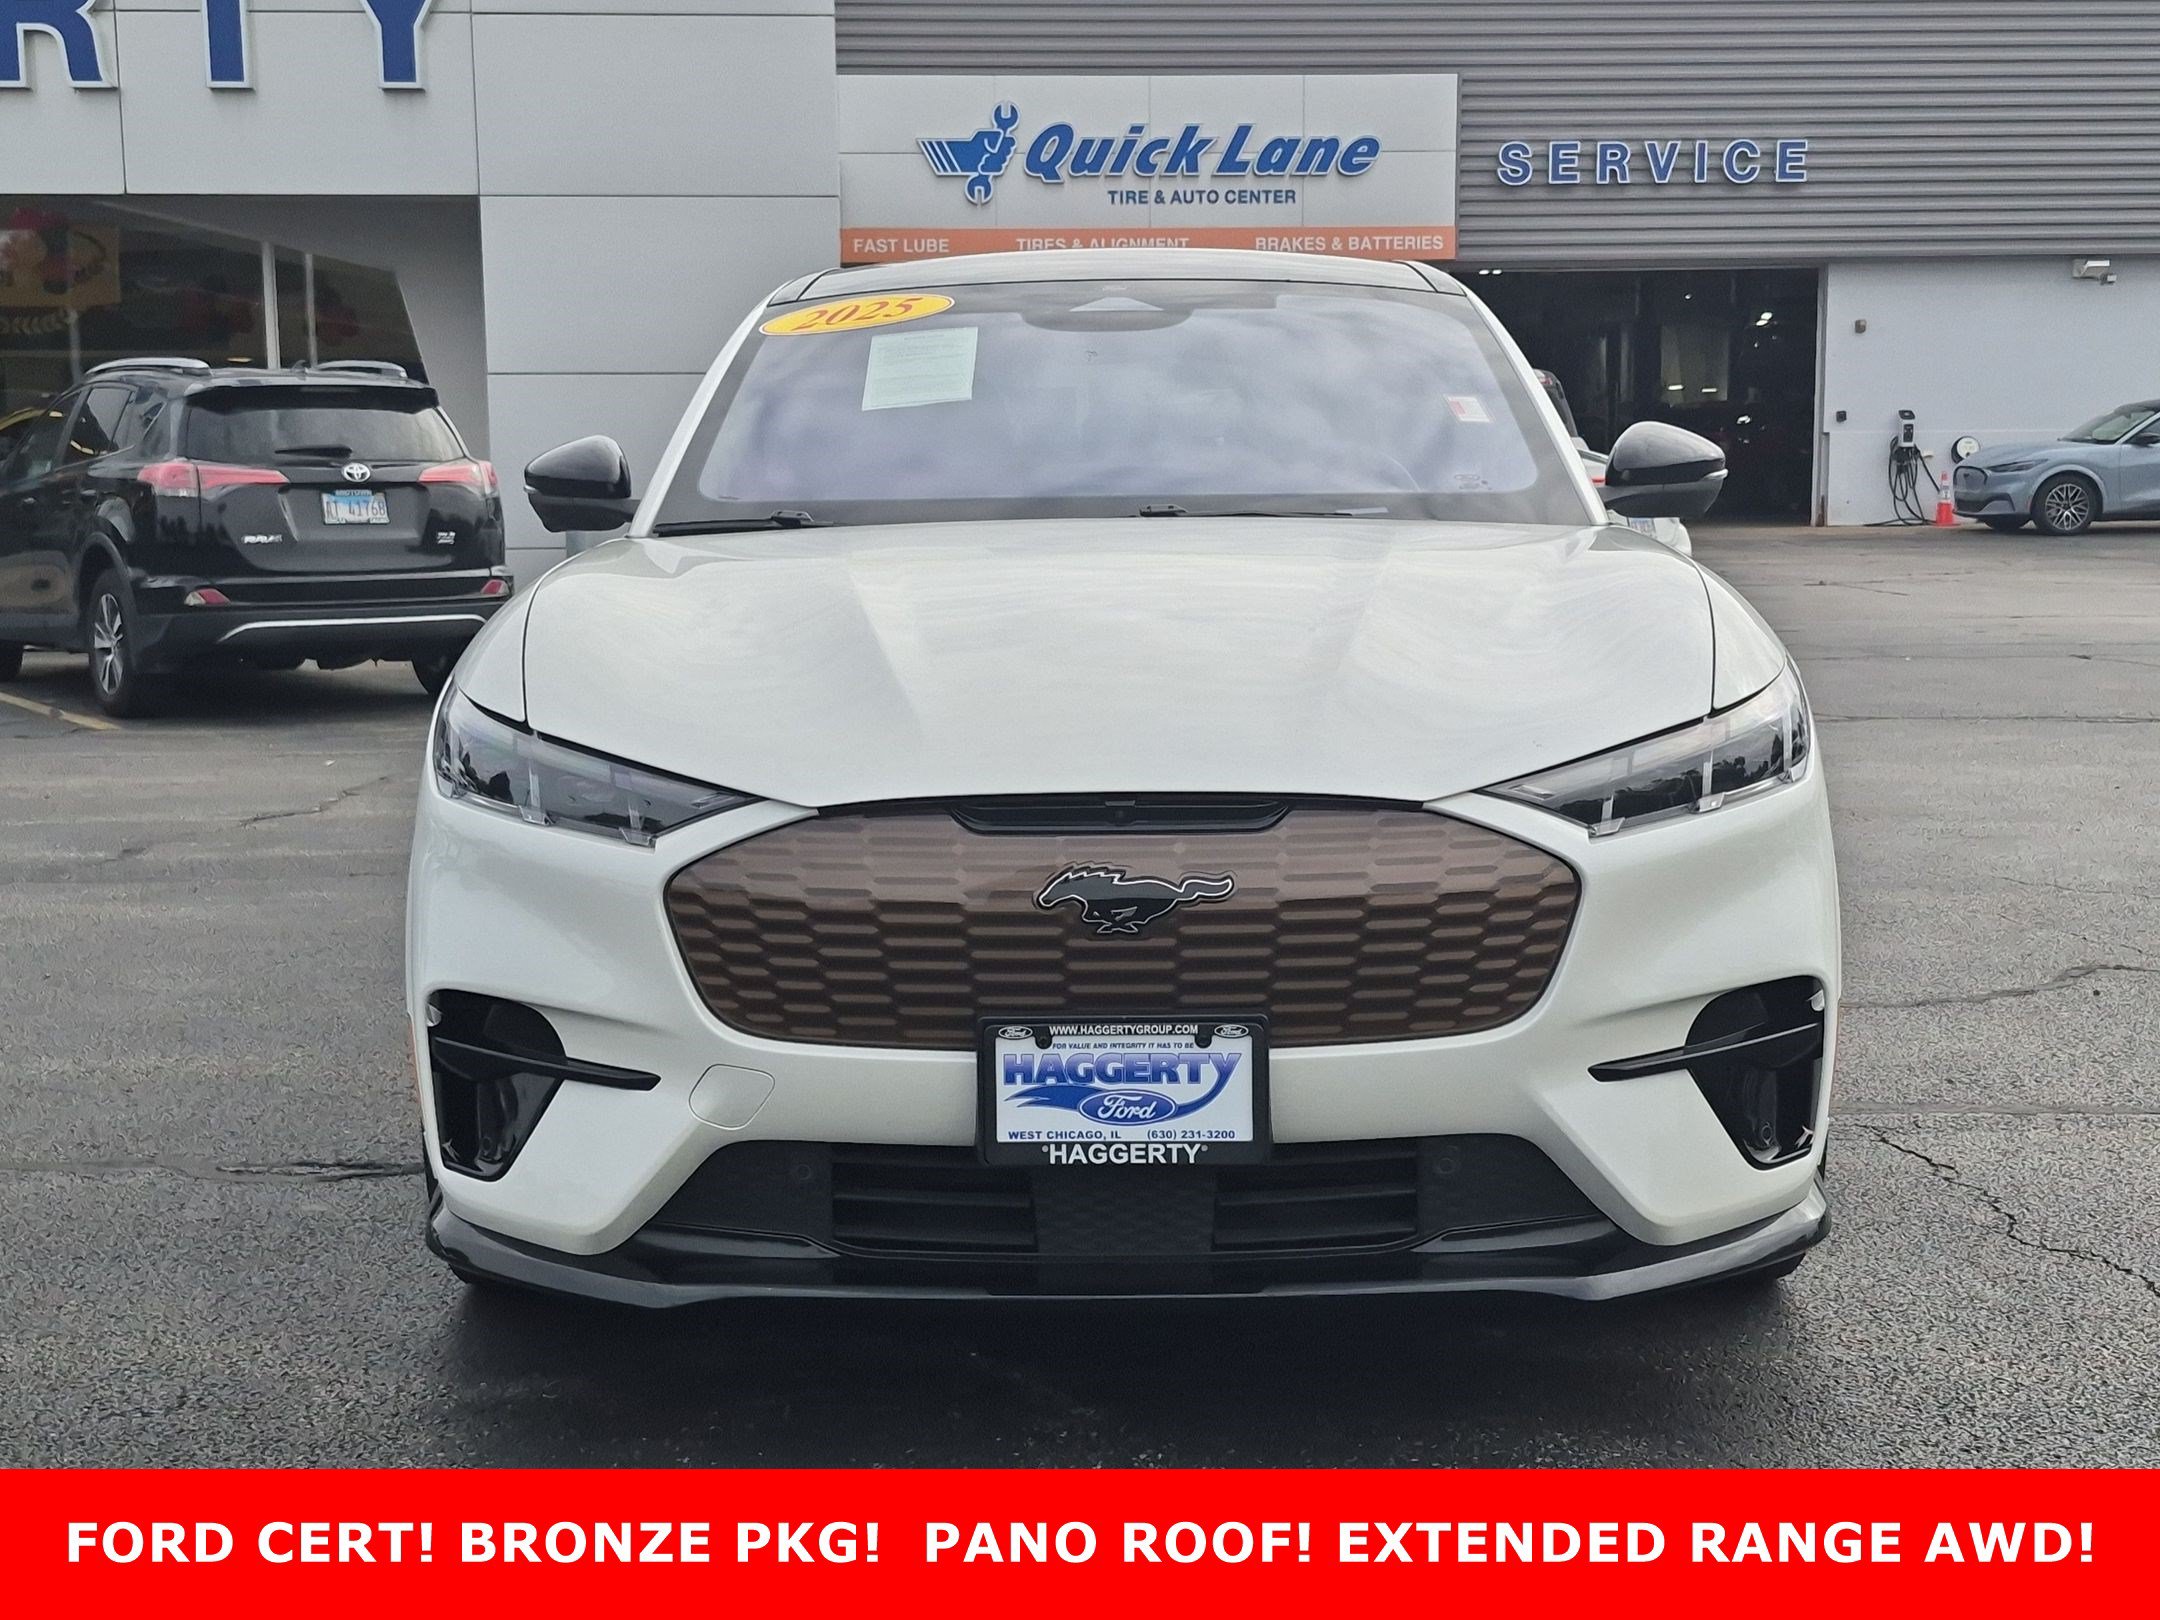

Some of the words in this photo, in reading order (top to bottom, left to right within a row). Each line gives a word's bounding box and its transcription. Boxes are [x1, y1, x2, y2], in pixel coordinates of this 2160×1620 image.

[1024, 122, 1216, 183] Quick
[1211, 122, 1383, 178] Lane
[1497, 139, 1808, 185] SERVICE
[1108, 190, 1149, 204] TIRE
[1154, 190, 1166, 204] &
[1170, 190, 1219, 204] AUTO
[1224, 190, 1296, 204] CENTER
[853, 238, 898, 253] FAST
[903, 238, 949, 253] LUBE
[1016, 237, 1067, 250] TIRES
[1089, 238, 1190, 249] ALIGNMENT
[1255, 236, 1326, 251] BRAKES
[1331, 237, 1343, 250] &
[1349, 235, 1444, 250] BATTERIES
[790, 297, 923, 331] 2025
[1049, 1024, 1199, 1036] WWW.HAGGERTYGROUP.COM
[1052, 1042, 1067, 1050] FOR
[1069, 1042, 1091, 1050] VALUE
[1093, 1042, 1108, 1050] AND
[1110, 1042, 1146, 1050] INTEGRITY
[1148, 1042, 1155, 1050] IT
[1157, 1042, 1171, 1050] HAS
[1173, 1042, 1183, 1050] TO
[1185, 1042, 1194, 1050] BE
[1003, 1053, 1241, 1086] HAGGERTY
[1097, 1095, 1157, 1119] Ford
[1009, 1131, 1042, 1140] WEST
[1047, 1131, 1107, 1142] CHICAGO,
[1111, 1131, 1122, 1139] IL
[1147, 1130, 1177, 1141] (630)
[1181, 1130, 1236, 1140] 231-3200
[1049, 1143, 1202, 1165] HAGGERTY
